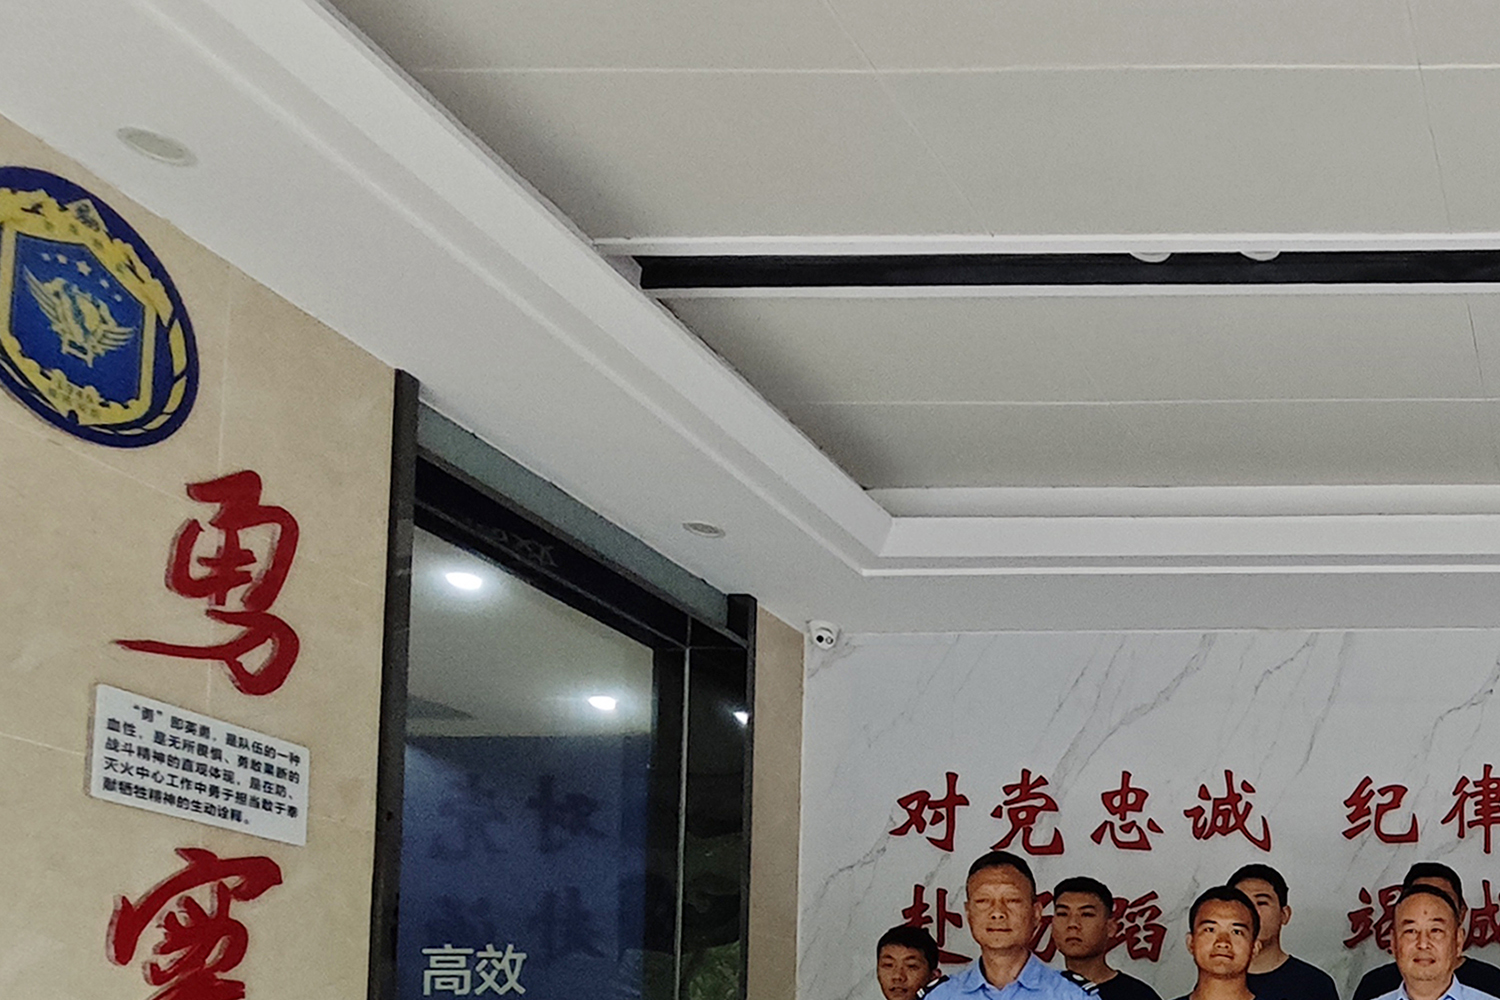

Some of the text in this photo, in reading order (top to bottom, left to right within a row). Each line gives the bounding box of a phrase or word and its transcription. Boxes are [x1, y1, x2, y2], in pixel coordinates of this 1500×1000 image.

[113, 469, 300, 695] 勇
[889, 768, 1271, 856] 对党忠诚
[421, 943, 527, 997] 高效
